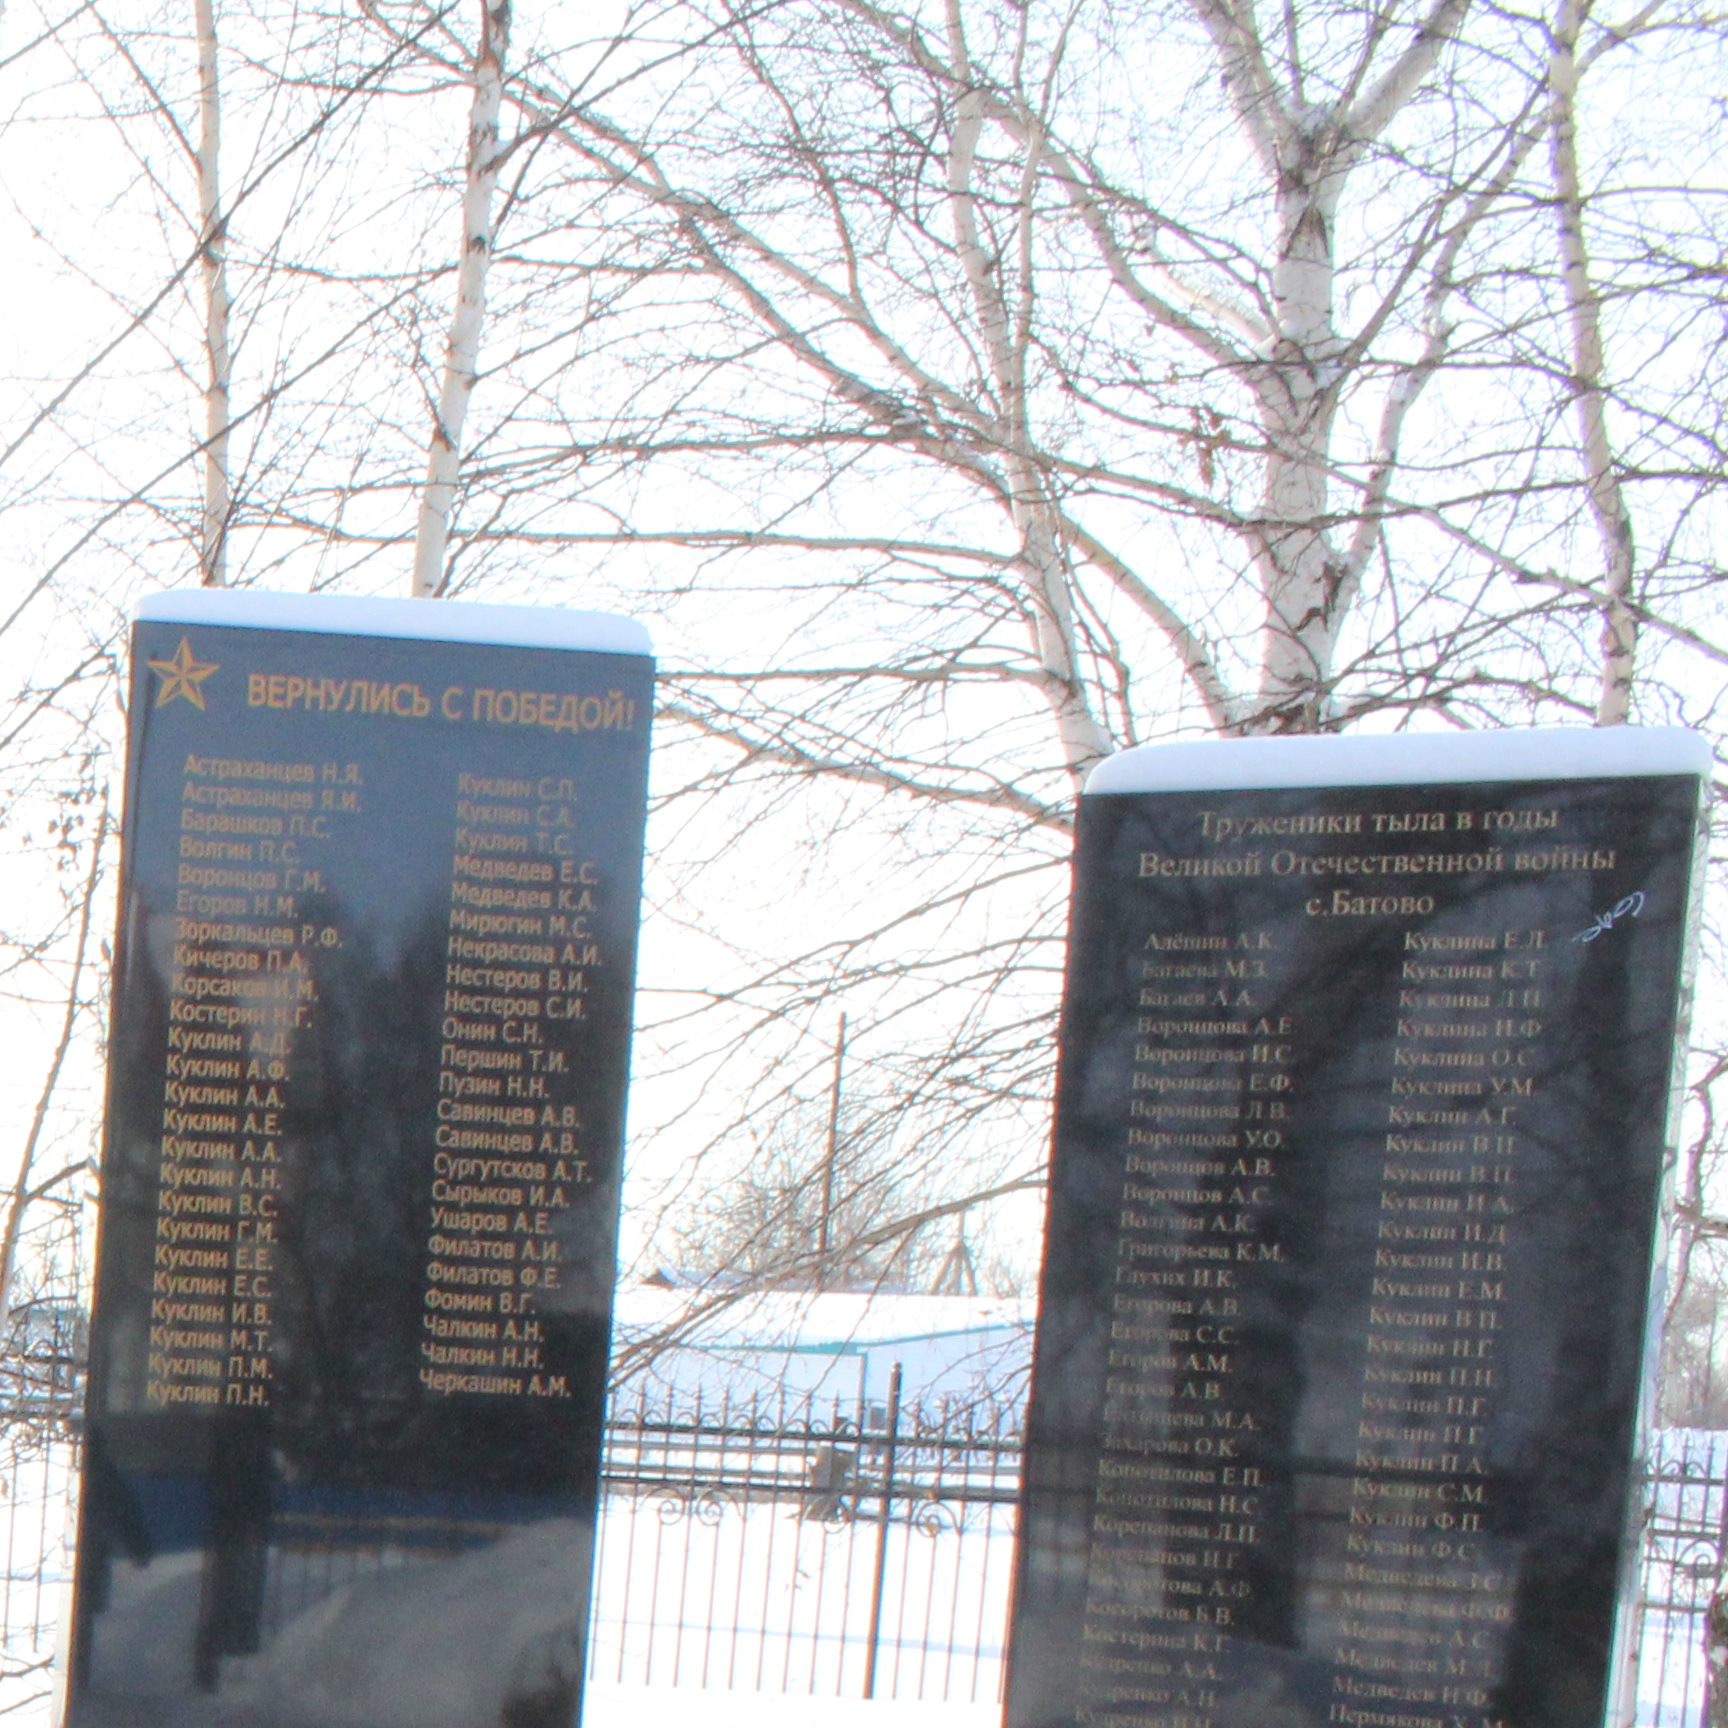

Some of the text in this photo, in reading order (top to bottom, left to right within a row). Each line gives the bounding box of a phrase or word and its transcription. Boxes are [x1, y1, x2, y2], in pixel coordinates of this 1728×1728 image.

[248, 674, 635, 733] ВЕРНУЛИСЬ С ПОБЕДОЙ!
[180, 808, 332, 838] Барашков П.С.
[1197, 810, 1559, 842] Труженики тыла в годы
[453, 855, 597, 884] Медведев Е.С.
[1138, 845, 1617, 877] Великой Отечественной войны
[1305, 889, 1435, 916] с.Батово
[175, 917, 343, 948] Зоркальцев Р.Ф.
[449, 909, 590, 938] Мирюгин М.С.
[173, 946, 309, 972] Кичеров П.А.
[445, 963, 587, 992] Нестеров В.И.
[441, 1017, 542, 1043] Онин С.Н.
[166, 1054, 289, 1080] Куклин А.Ф.
[440, 1044, 568, 1072] Першин Т.И.
[163, 1109, 281, 1135] Куклин А.Е.
[437, 1098, 579, 1127] Савинцев А.В.
[160, 1163, 281, 1189] Куклин А.Н.
[433, 1152, 591, 1182] Сургутсков А.Т.
[158, 1190, 277, 1216] Куклин В.С.
[431, 1179, 568, 1207] Сырыков И.А.
[156, 1217, 277, 1242] Куклин Г.М.
[431, 1207, 551, 1233] Ушаров А.Е.
[154, 1244, 272, 1270] Куклин Е.Е.
[426, 1262, 559, 1288] Филатов Ф.Е.
[151, 1299, 271, 1324] Куклин И.В.
[424, 1289, 534, 1313] Фомин В.Г.
[150, 1326, 273, 1351] Куклин М.Т.
[419, 1369, 570, 1397] Черкашин А.М.
